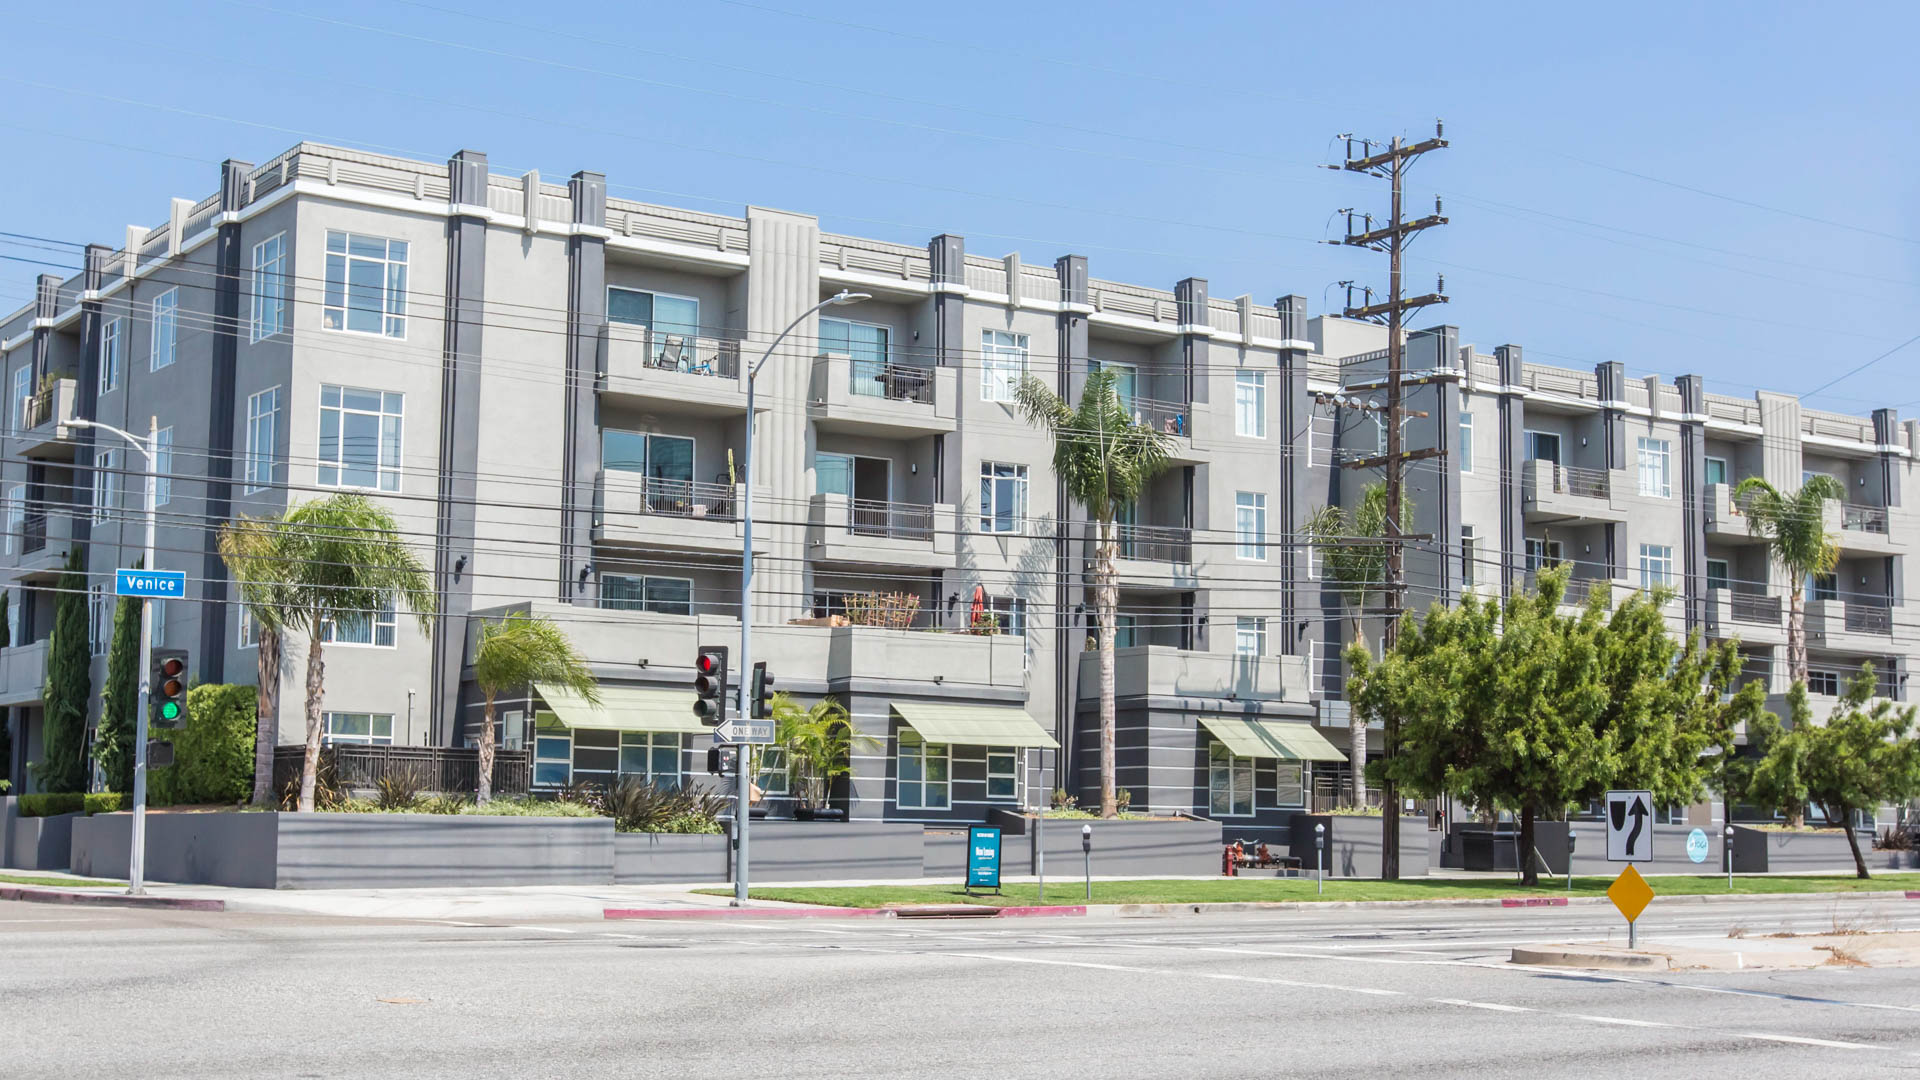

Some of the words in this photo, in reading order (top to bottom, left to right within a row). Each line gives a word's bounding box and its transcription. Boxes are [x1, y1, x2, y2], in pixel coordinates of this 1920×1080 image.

[127, 576, 175, 590] Venice
[732, 726, 749, 736] ONE
[751, 727, 768, 736] WAY
